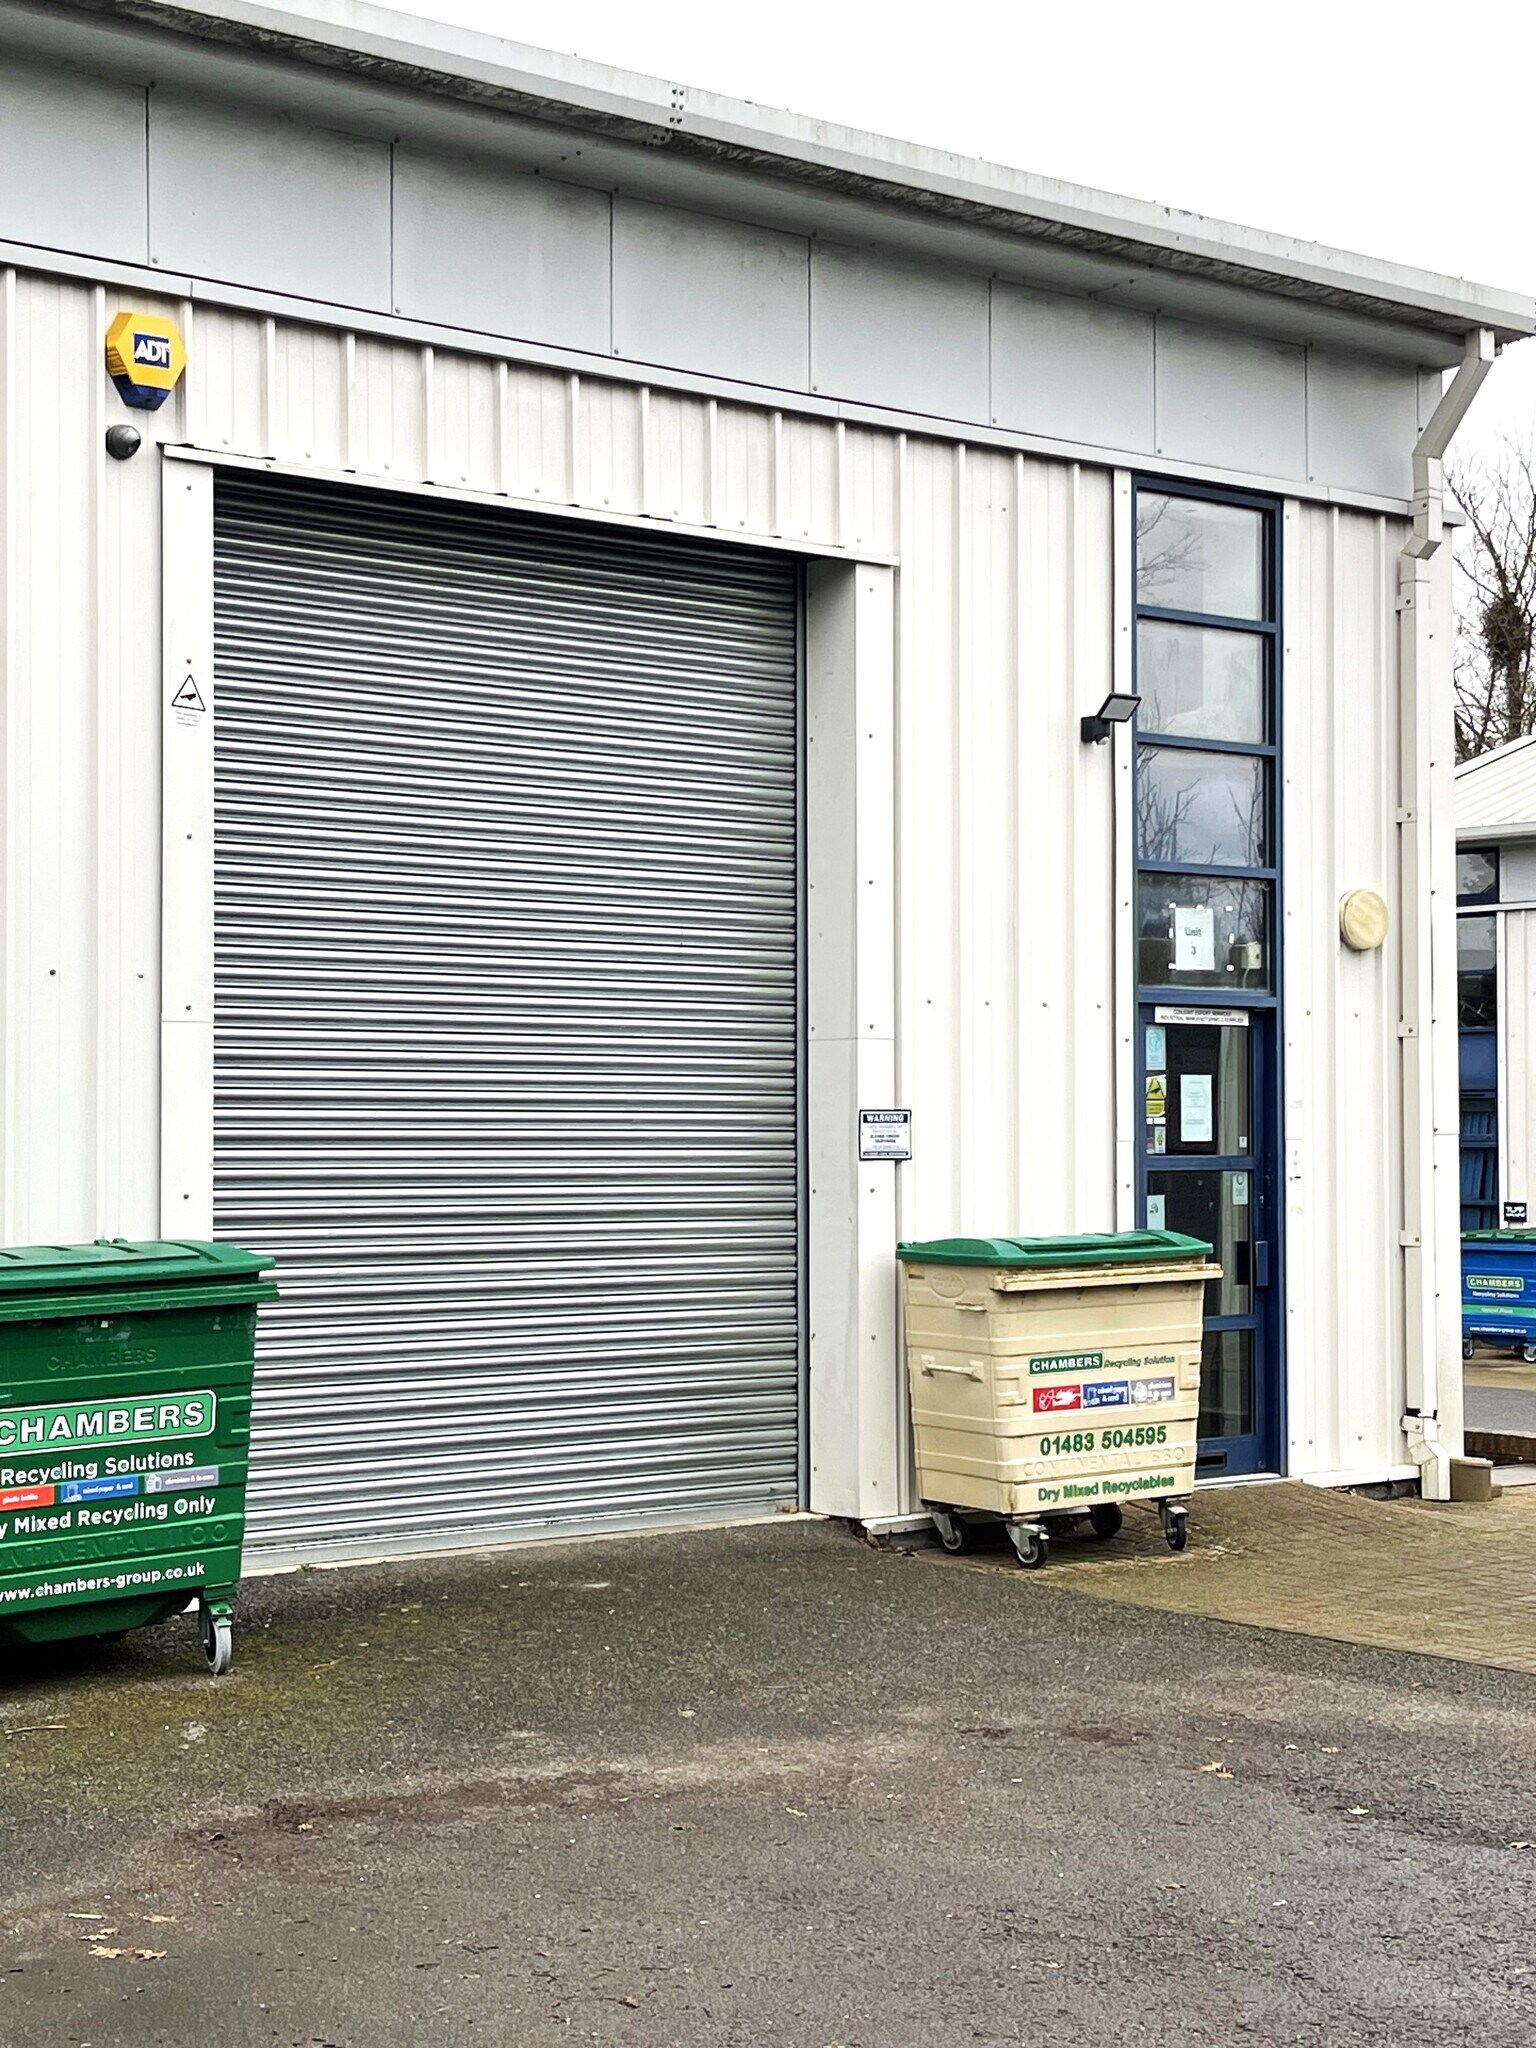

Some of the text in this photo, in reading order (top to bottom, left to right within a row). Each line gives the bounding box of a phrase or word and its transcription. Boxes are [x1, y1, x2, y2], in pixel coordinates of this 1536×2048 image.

[134, 339, 170, 363] ADT
[1184, 927, 1202, 937] Unit
[867, 1114, 904, 1122] WARNING
[1469, 1278, 1521, 1288] CHAMBERS
[47, 1347, 158, 1371] CHAMBERS
[1032, 1356, 1100, 1371] CHAMBERS
[1104, 1358, 1141, 1369] Recycling
[0, 1401, 205, 1446] CHAMBERS
[1040, 1425, 1167, 1456] 01483 504595
[1, 1452, 194, 1486] Recycling Solutions
[1024, 1451, 1142, 1477] CONTINENTAL
[1038, 1474, 1174, 1502] Dry Mixed Recyclables
[14, 1511, 71, 1534] Mixed
[78, 1503, 168, 1526] Recycling
[174, 1495, 216, 1514] Only
